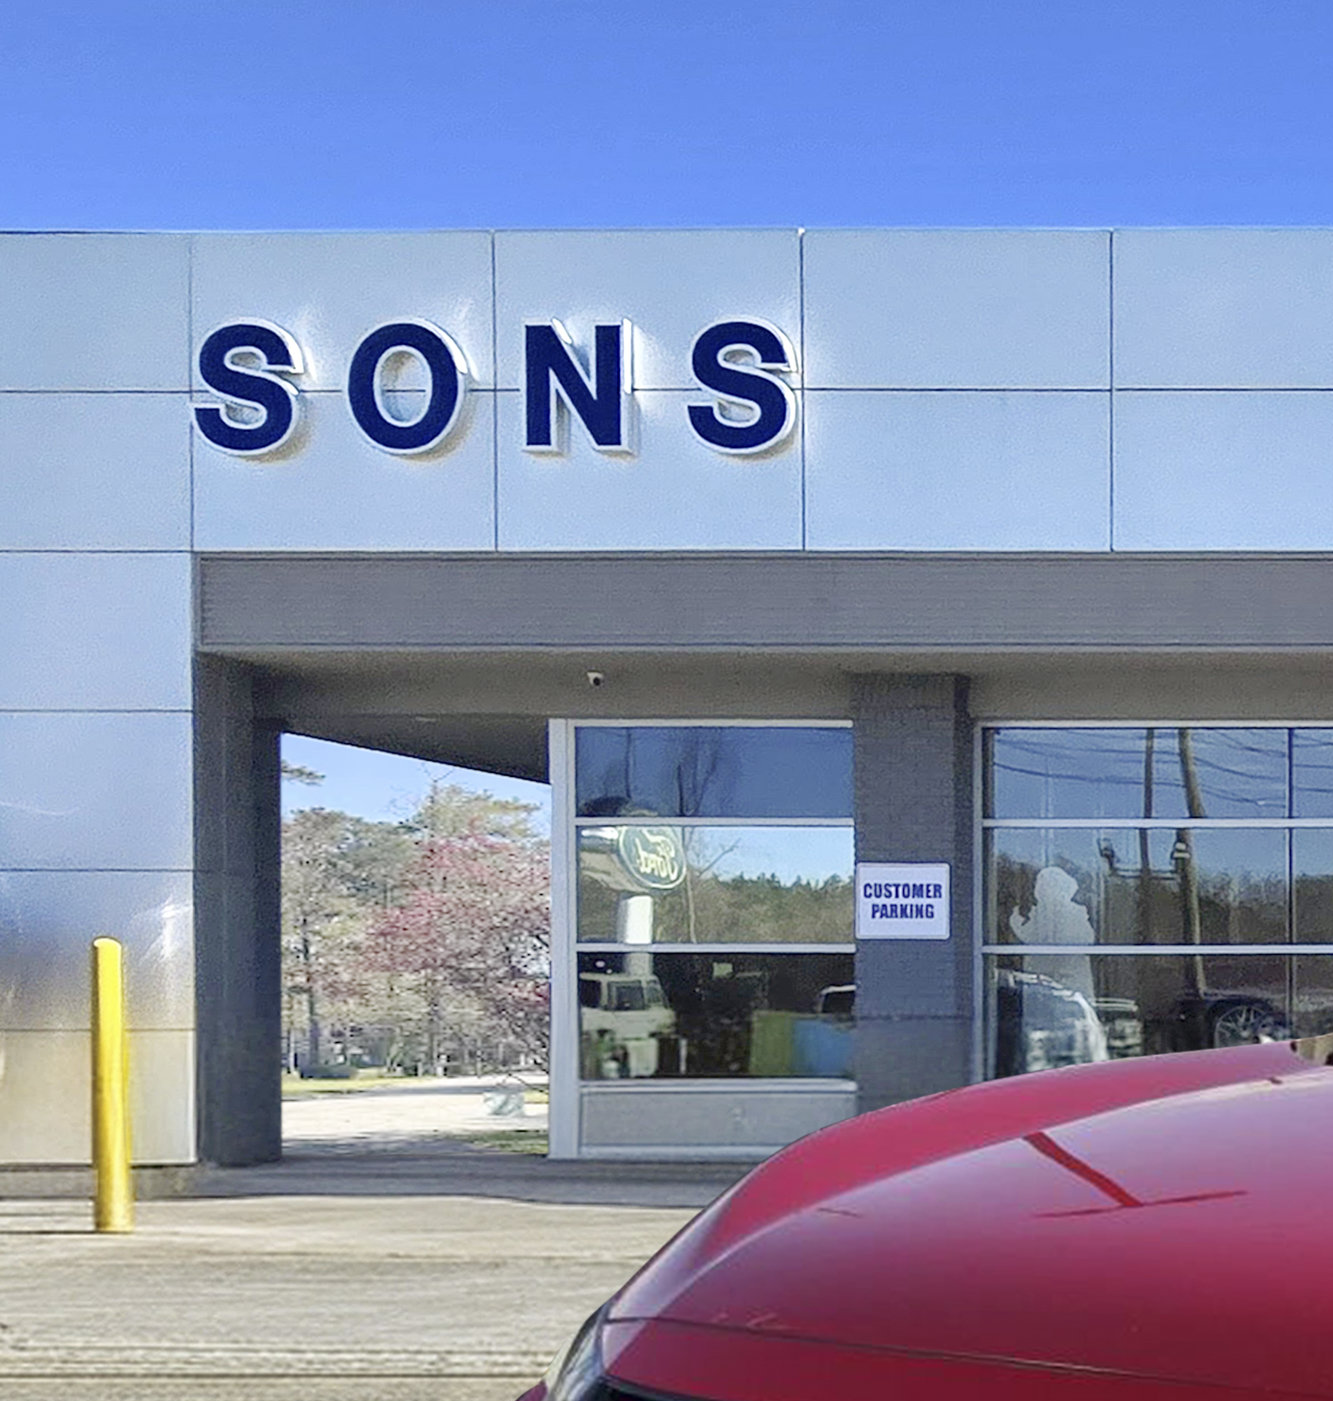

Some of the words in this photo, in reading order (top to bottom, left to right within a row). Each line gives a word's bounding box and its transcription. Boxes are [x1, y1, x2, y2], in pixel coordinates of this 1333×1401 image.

[193, 321, 795, 452] SONS
[863, 883, 943, 899] CUSTOMER
[871, 903, 935, 919] PARKING
